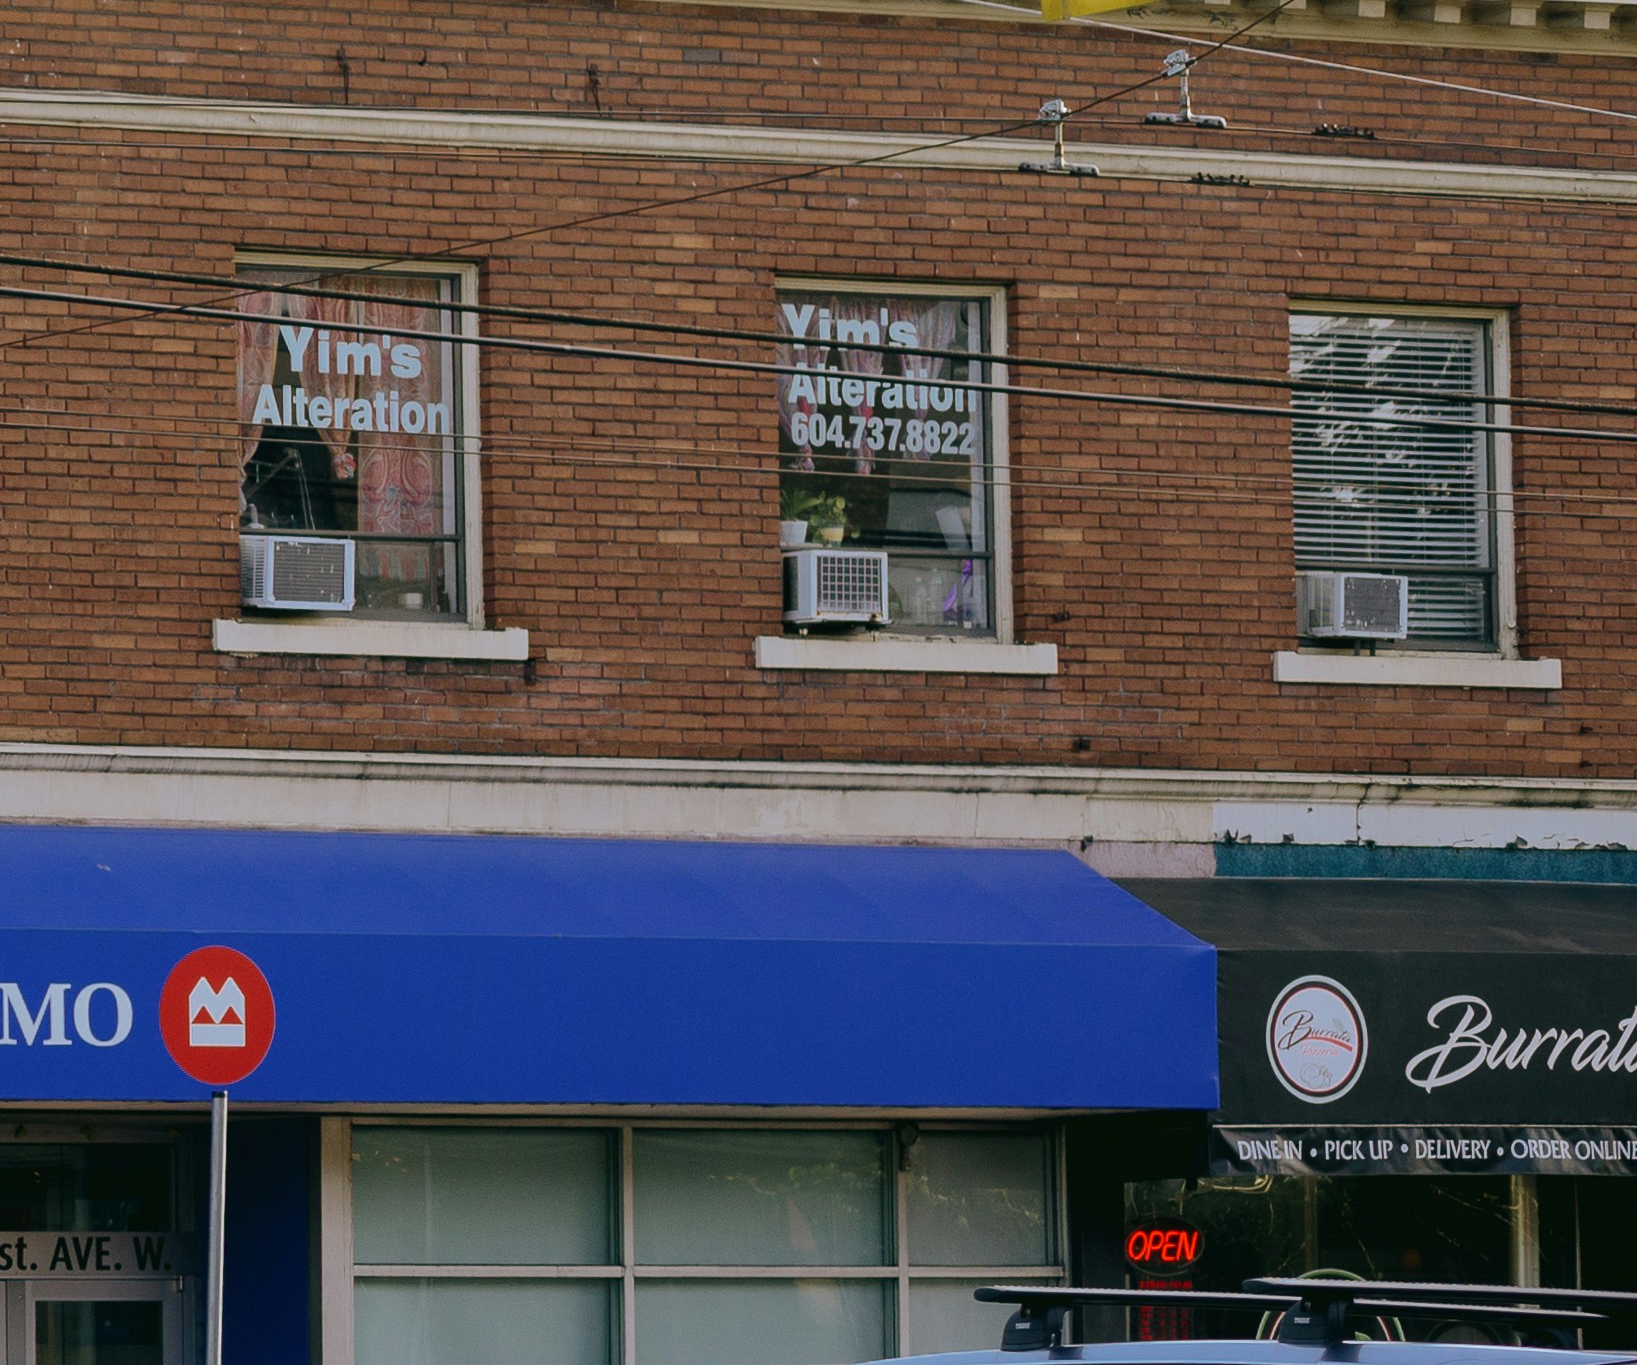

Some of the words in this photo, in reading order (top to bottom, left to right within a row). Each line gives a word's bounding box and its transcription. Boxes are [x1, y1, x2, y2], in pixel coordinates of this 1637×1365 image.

[782, 304, 919, 351] Yim's
[278, 325, 423, 380] Yim's
[251, 383, 450, 435] Alteration
[788, 363, 977, 412] Alteration
[791, 412, 976, 455] 604.737.8822
[1278, 1010, 1352, 1050] Burrata
[1238, 1141, 1281, 1159] DINE
[1283, 1141, 1302, 1159] IN
[1325, 1141, 1365, 1159] PICK
[1369, 1140, 1394, 1159] UP
[1415, 1140, 1491, 1159] DELIVERY
[1510, 1140, 1572, 1159] ORDER
[1574, 1140, 1637, 1160] ONLINE
[49, 1238, 123, 1271] AVE.
[134, 1238, 172, 1271] W.
[1128, 1230, 1198, 1261] OPEN
